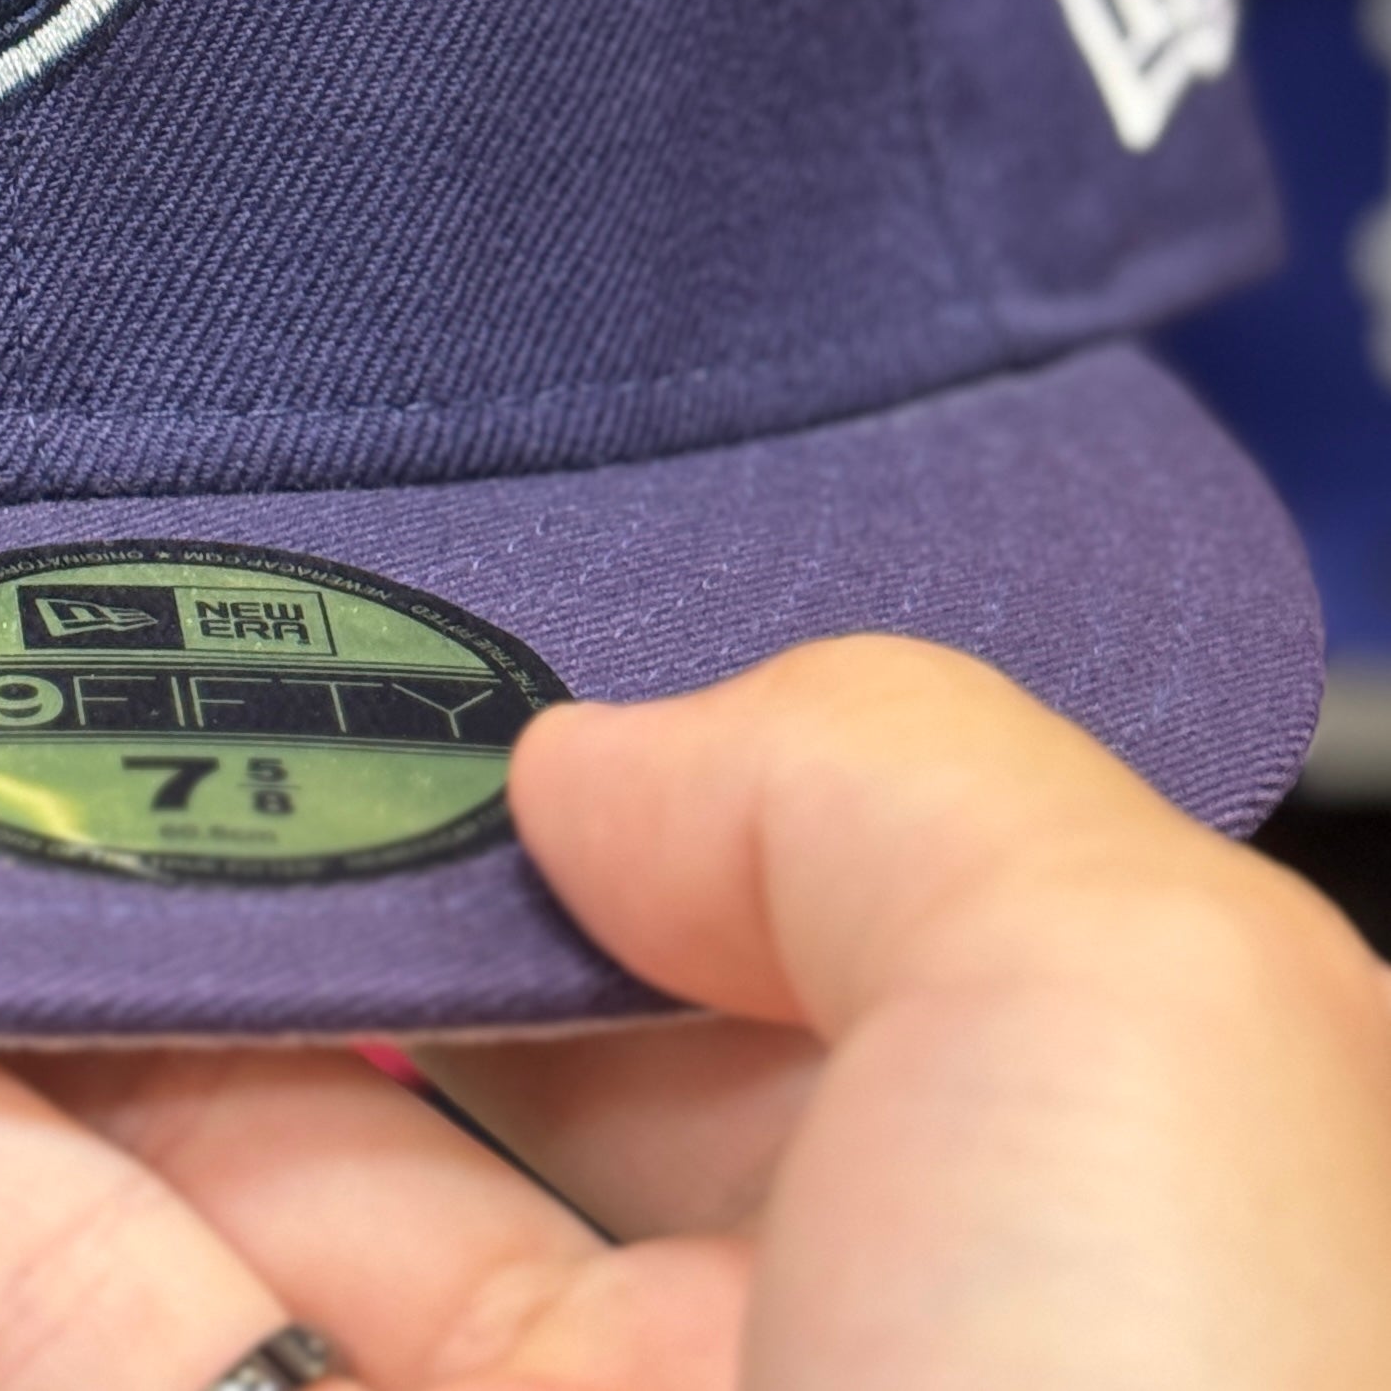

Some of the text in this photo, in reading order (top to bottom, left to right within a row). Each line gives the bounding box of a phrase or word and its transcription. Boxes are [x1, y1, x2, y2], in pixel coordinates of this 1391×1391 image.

[195, 599, 306, 621] NEW
[199, 619, 310, 643] ERA
[121, 755, 220, 811] 7
